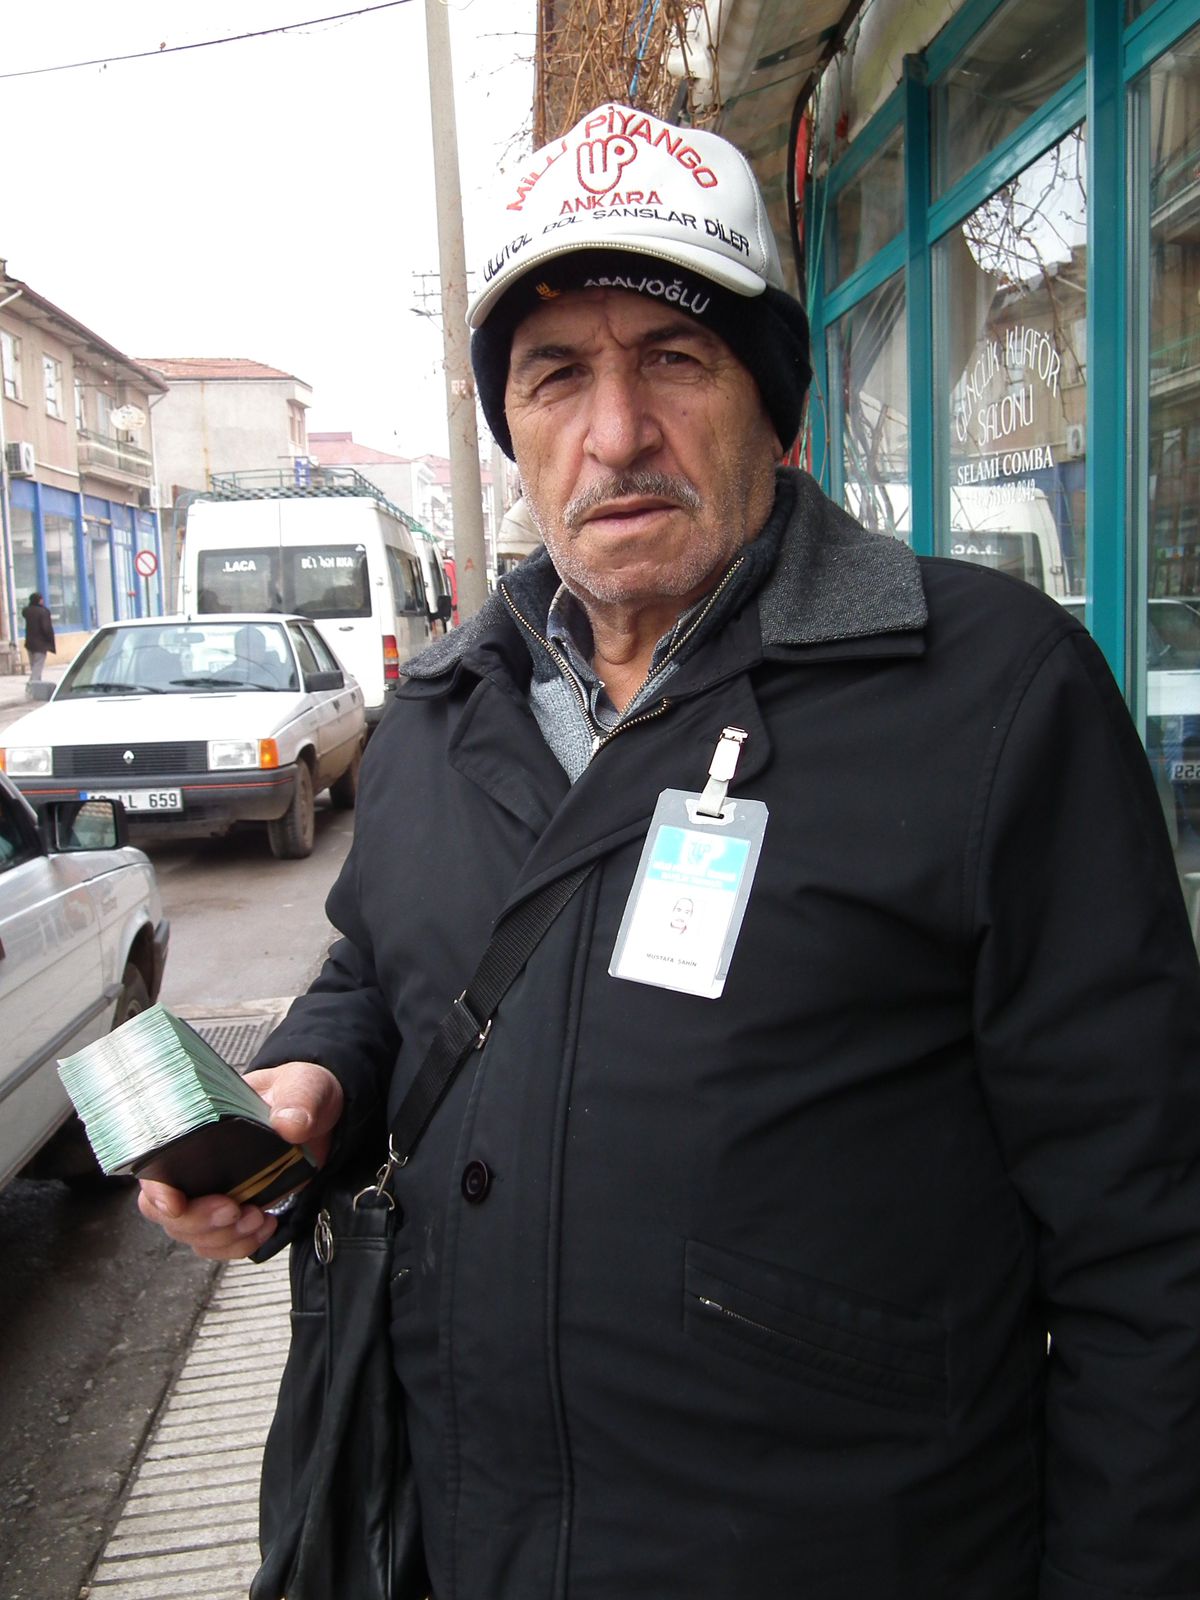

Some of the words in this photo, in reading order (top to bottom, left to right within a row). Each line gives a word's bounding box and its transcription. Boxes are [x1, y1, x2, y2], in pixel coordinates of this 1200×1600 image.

[585, 106, 718, 188] PİYANGO
[558, 191, 664, 216] ANKARA
[704, 217, 750, 257] DİLER
[977, 383, 1034, 446] SALONU
[957, 452, 1000, 486] SELAMİ
[1002, 445, 1054, 477] COMBA
[148, 792, 178, 808] 659
